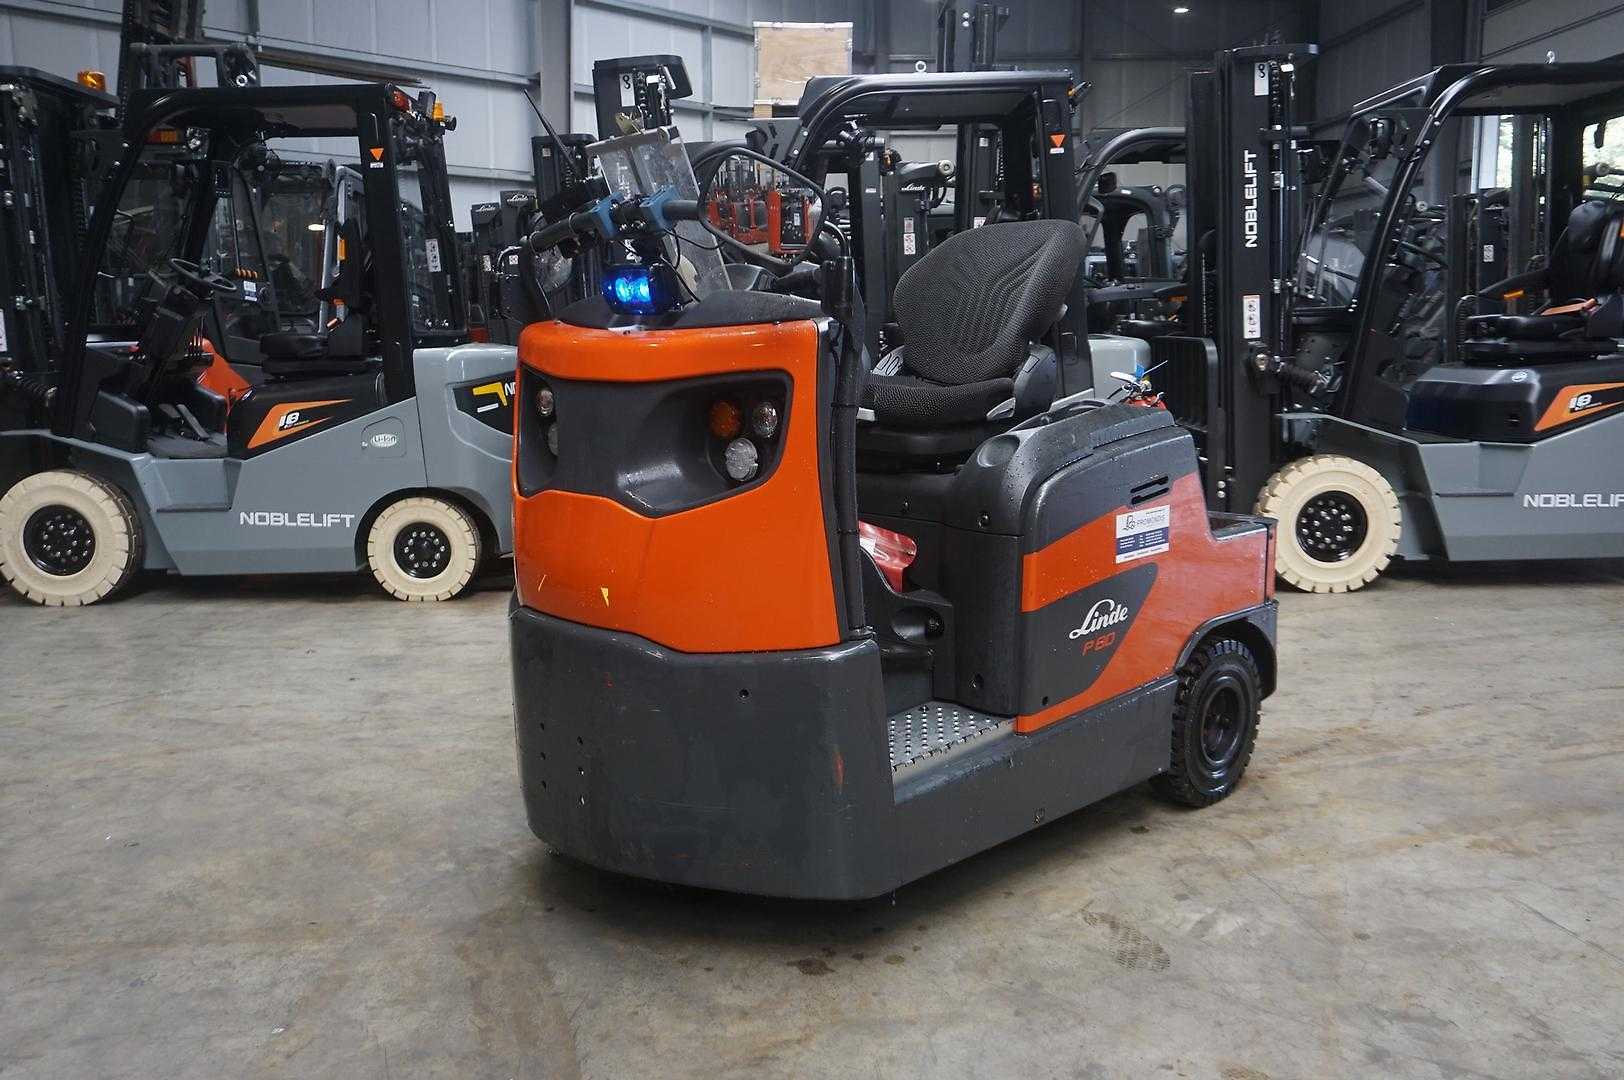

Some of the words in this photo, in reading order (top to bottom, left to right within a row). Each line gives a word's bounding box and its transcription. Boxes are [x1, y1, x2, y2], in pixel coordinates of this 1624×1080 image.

[1244, 149, 1258, 249] NOBLELIFT
[1568, 393, 1592, 409] 18
[279, 411, 300, 427] 18
[239, 511, 355, 528] NOBLELIFT
[1069, 599, 1128, 639] Linde
